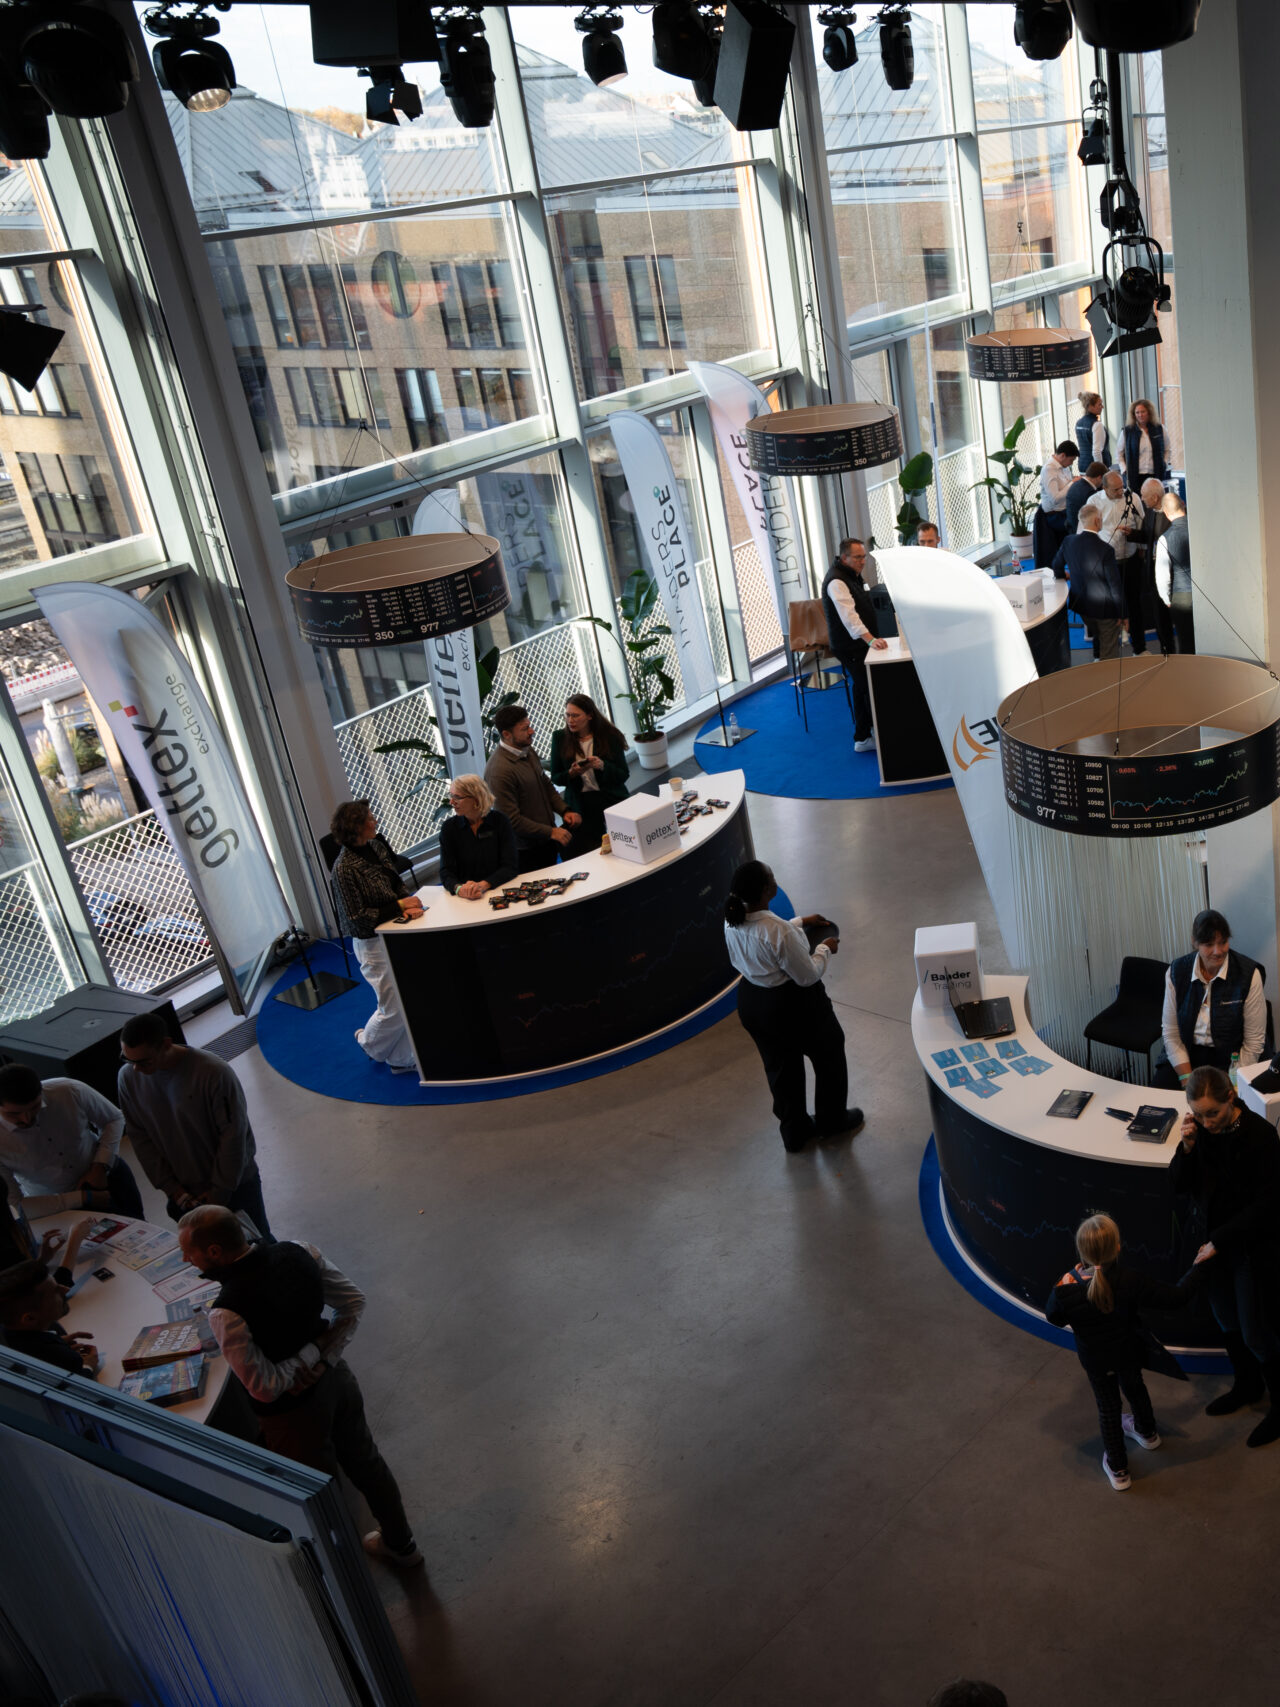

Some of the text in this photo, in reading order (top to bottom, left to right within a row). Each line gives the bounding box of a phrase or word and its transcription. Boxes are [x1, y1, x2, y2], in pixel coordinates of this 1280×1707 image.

[854, 458, 867, 466] 350
[658, 485, 690, 589] PLACE
[420, 621, 439, 633] 977
[375, 631, 394, 640] 350
[434, 632, 475, 756] gette
[165, 674, 210, 755] exchange
[132, 708, 239, 868] gettex
[1036, 805, 1056, 820] 977
[1177, 817, 1195, 825] 13:20
[610, 830, 634, 844] gettex
[645, 823, 672, 845] gettex
